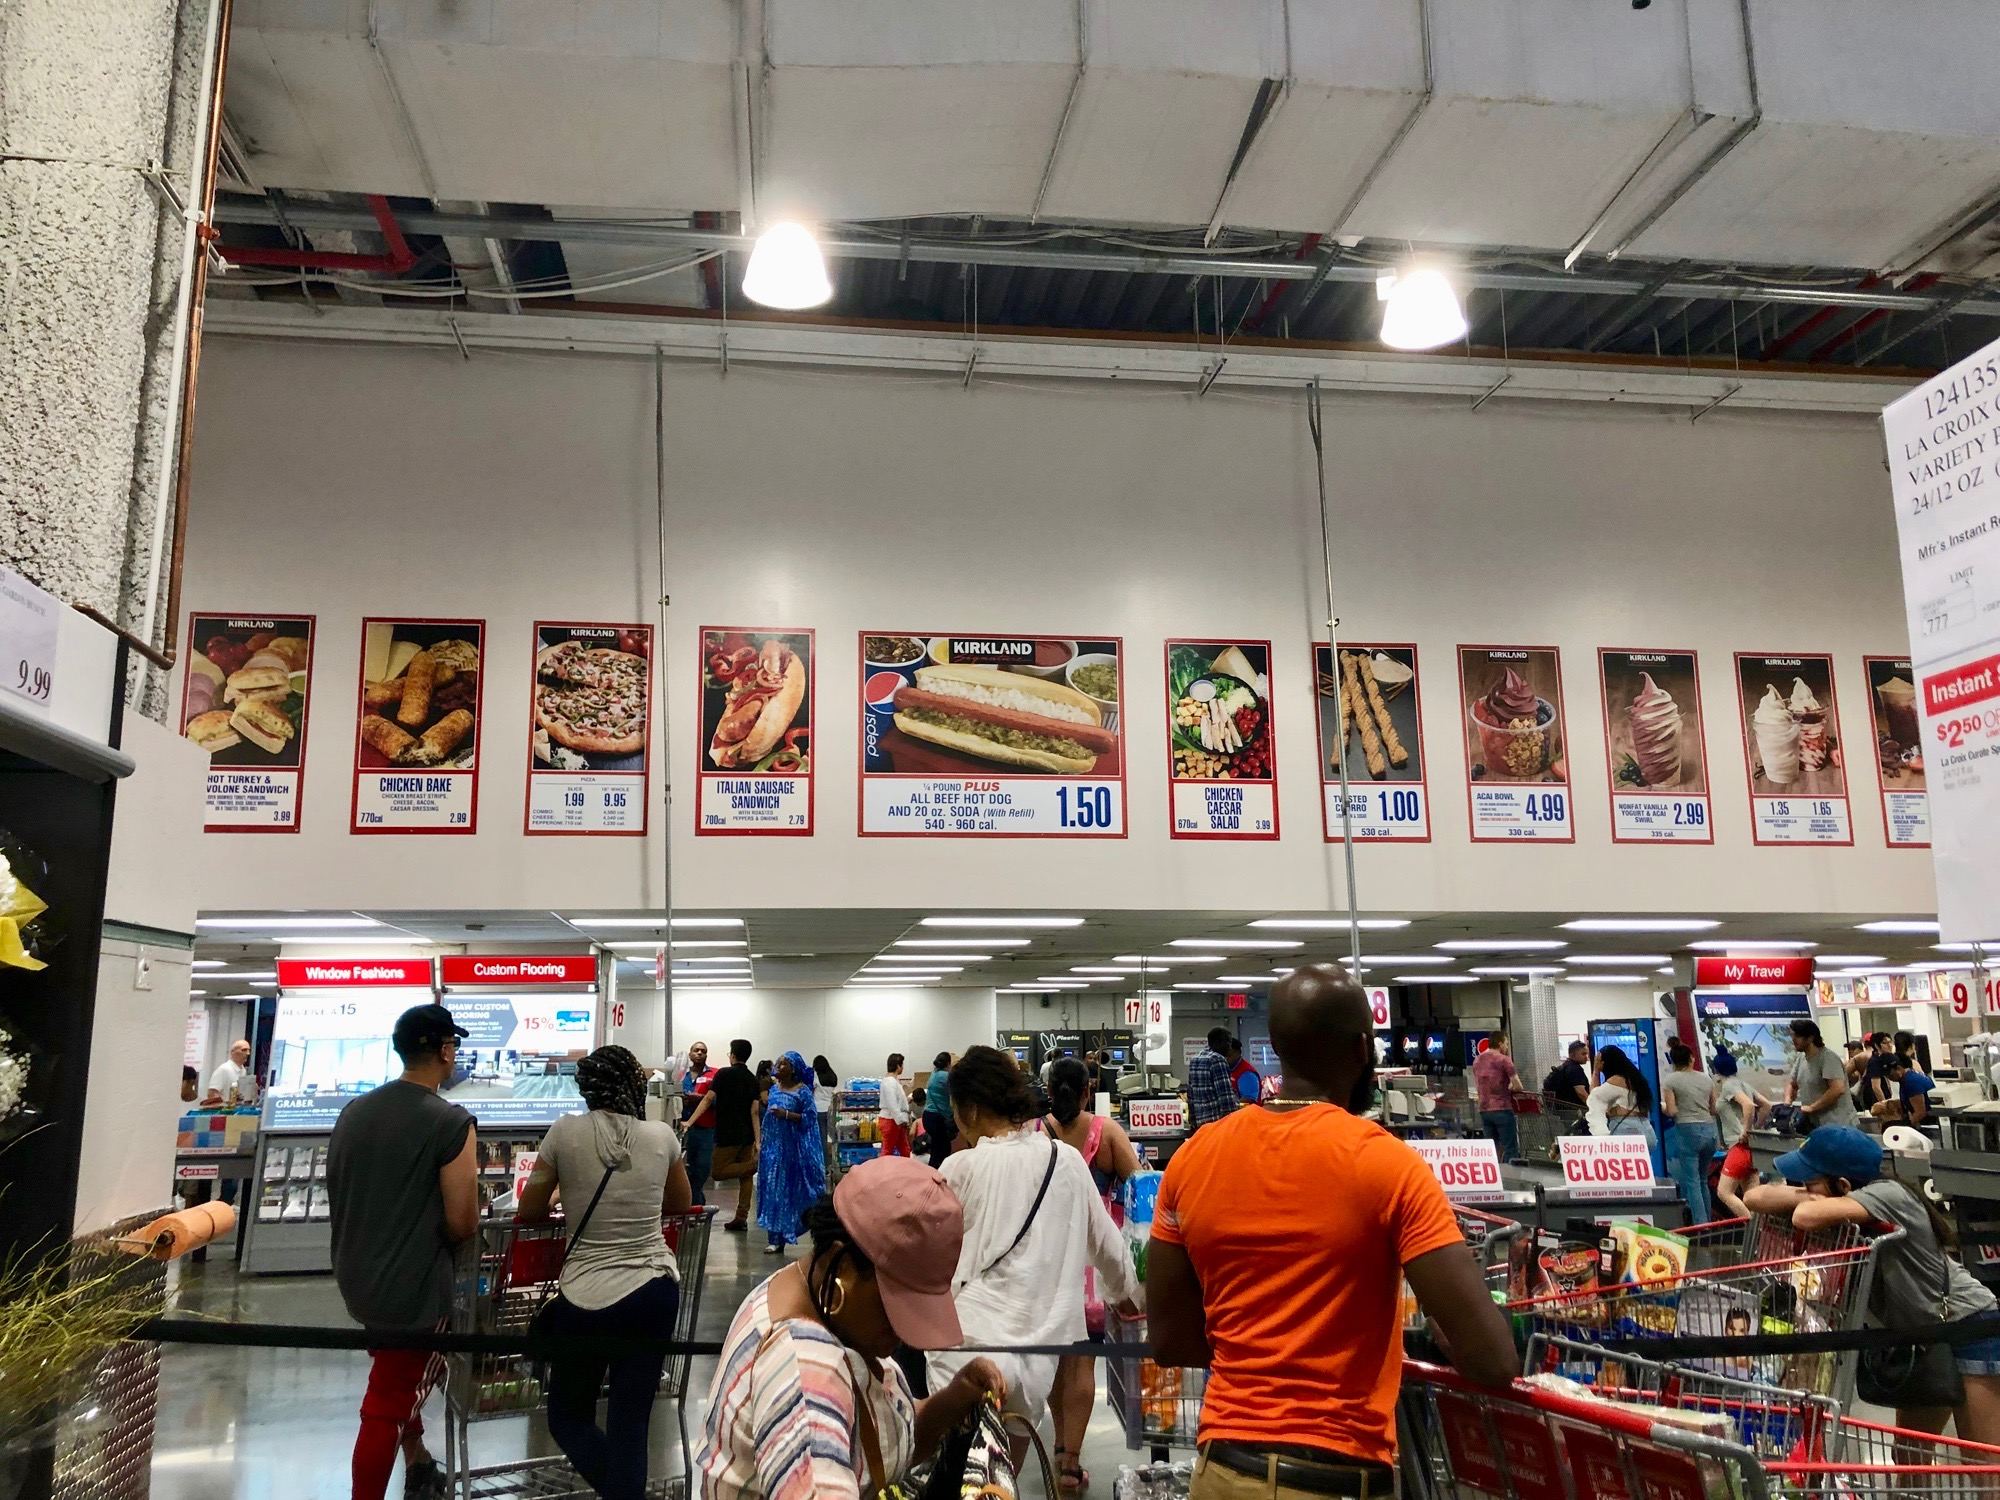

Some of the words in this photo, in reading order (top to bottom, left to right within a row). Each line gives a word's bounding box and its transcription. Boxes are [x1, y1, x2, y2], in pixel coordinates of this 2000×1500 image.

[1925, 355, 2000, 420] 124135
[1905, 437, 1929, 461] LA
[1933, 400, 1990, 445] CROIX
[1909, 432, 1987, 486] VARIETY
[1912, 482, 1953, 516] 24/12
[1957, 467, 1984, 493] OZ
[1949, 522, 1987, 547] Instant
[228, 620, 275, 629] KIRKLAND
[570, 629, 615, 637] KIRKLAND
[953, 641, 1033, 655] KIRKLAND
[1489, 651, 1528, 659] KIRKLAND
[1629, 654, 1667, 662] KIRKLAND
[17, 659, 51, 700] 9.99
[1931, 667, 1994, 704] Instant
[865, 713, 880, 757] pepsi
[207, 775, 225, 784] HOT
[227, 775, 262, 784] TURKEY
[264, 775, 271, 784] &
[380, 777, 423, 792] CHICKEN
[426, 777, 452, 792] BAKE
[206, 785, 240, 794] VOLONE
[242, 785, 289, 794] SANDWICH
[716, 781, 752, 794] ITALIAN
[754, 781, 795, 795] SAUSAGE
[933, 783, 962, 792] POUND
[963, 782, 1001, 792] PLUS
[1204, 787, 1243, 801] CHICKEN
[564, 792, 585, 807] 1.99
[604, 793, 626, 807] 9.95
[731, 795, 780, 809] SANDWICH
[910, 794, 932, 805] ALL
[934, 794, 960, 805] BEEF
[963, 794, 987, 805] HOT
[989, 794, 1012, 805] DOG
[1333, 795, 1368, 803] TSTED
[1378, 791, 1420, 821] 1.00
[888, 806, 911, 817] AND
[914, 806, 928, 817] 20
[931, 809, 946, 817] oz.
[950, 806, 980, 817] SODA
[983, 808, 1007, 819] (With
[1008, 808, 1035, 820] Refill)
[1055, 786, 1112, 828] 1.50
[1207, 801, 1242, 815] CAESAR
[1335, 803, 1367, 812] CRRO
[1526, 793, 1565, 822] 4.99
[1673, 803, 1704, 825] 2.99
[1770, 801, 1790, 815] 1.35
[1813, 801, 1832, 815] 1.65
[273, 811, 291, 822] 3.99
[449, 812, 467, 823] 2.99
[788, 815, 805, 825] 2.79
[1210, 815, 1240, 830] SALAD
[924, 819, 945, 830] 540
[955, 819, 975, 830] 960
[978, 819, 997, 830] cal.
[1255, 820, 1271, 830] 3.99
[1361, 828, 1376, 836] 530
[1377, 828, 1393, 836] cal.
[1508, 828, 1522, 836] 330
[305, 966, 351, 980] Window
[353, 966, 405, 979] Fashions
[473, 963, 517, 976] Custom
[520, 963, 566, 978] Flooring
[1724, 965, 1745, 980] My
[1748, 964, 1785, 978] Travel
[1229, 994, 1246, 1009] EXIT
[1952, 982, 1968, 1014] 9
[339, 1003, 356, 1015] 15
[447, 1003, 474, 1011] SHAW
[473, 1003, 510, 1011] CUSTOM
[1126, 1001, 1141, 1023] 17
[1150, 1001, 1161, 1023] 18
[612, 1003, 625, 1027] 16
[523, 1017, 555, 1030] 15%
[275, 1099, 315, 1108] GRABER
[1131, 1103, 1152, 1112] Sorry,
[1153, 1103, 1166, 1111] this
[1167, 1103, 1180, 1111] lane
[1132, 1113, 1182, 1127] CLOSED
[1447, 1145, 1467, 1157] this
[1470, 1145, 1493, 1157] lane
[1563, 1142, 1598, 1156] Sorry,
[1600, 1142, 1620, 1154] this
[1622, 1142, 1646, 1153] lane
[1429, 1162, 1498, 1186] LOSED
[1566, 1158, 1650, 1182] CLOSED
